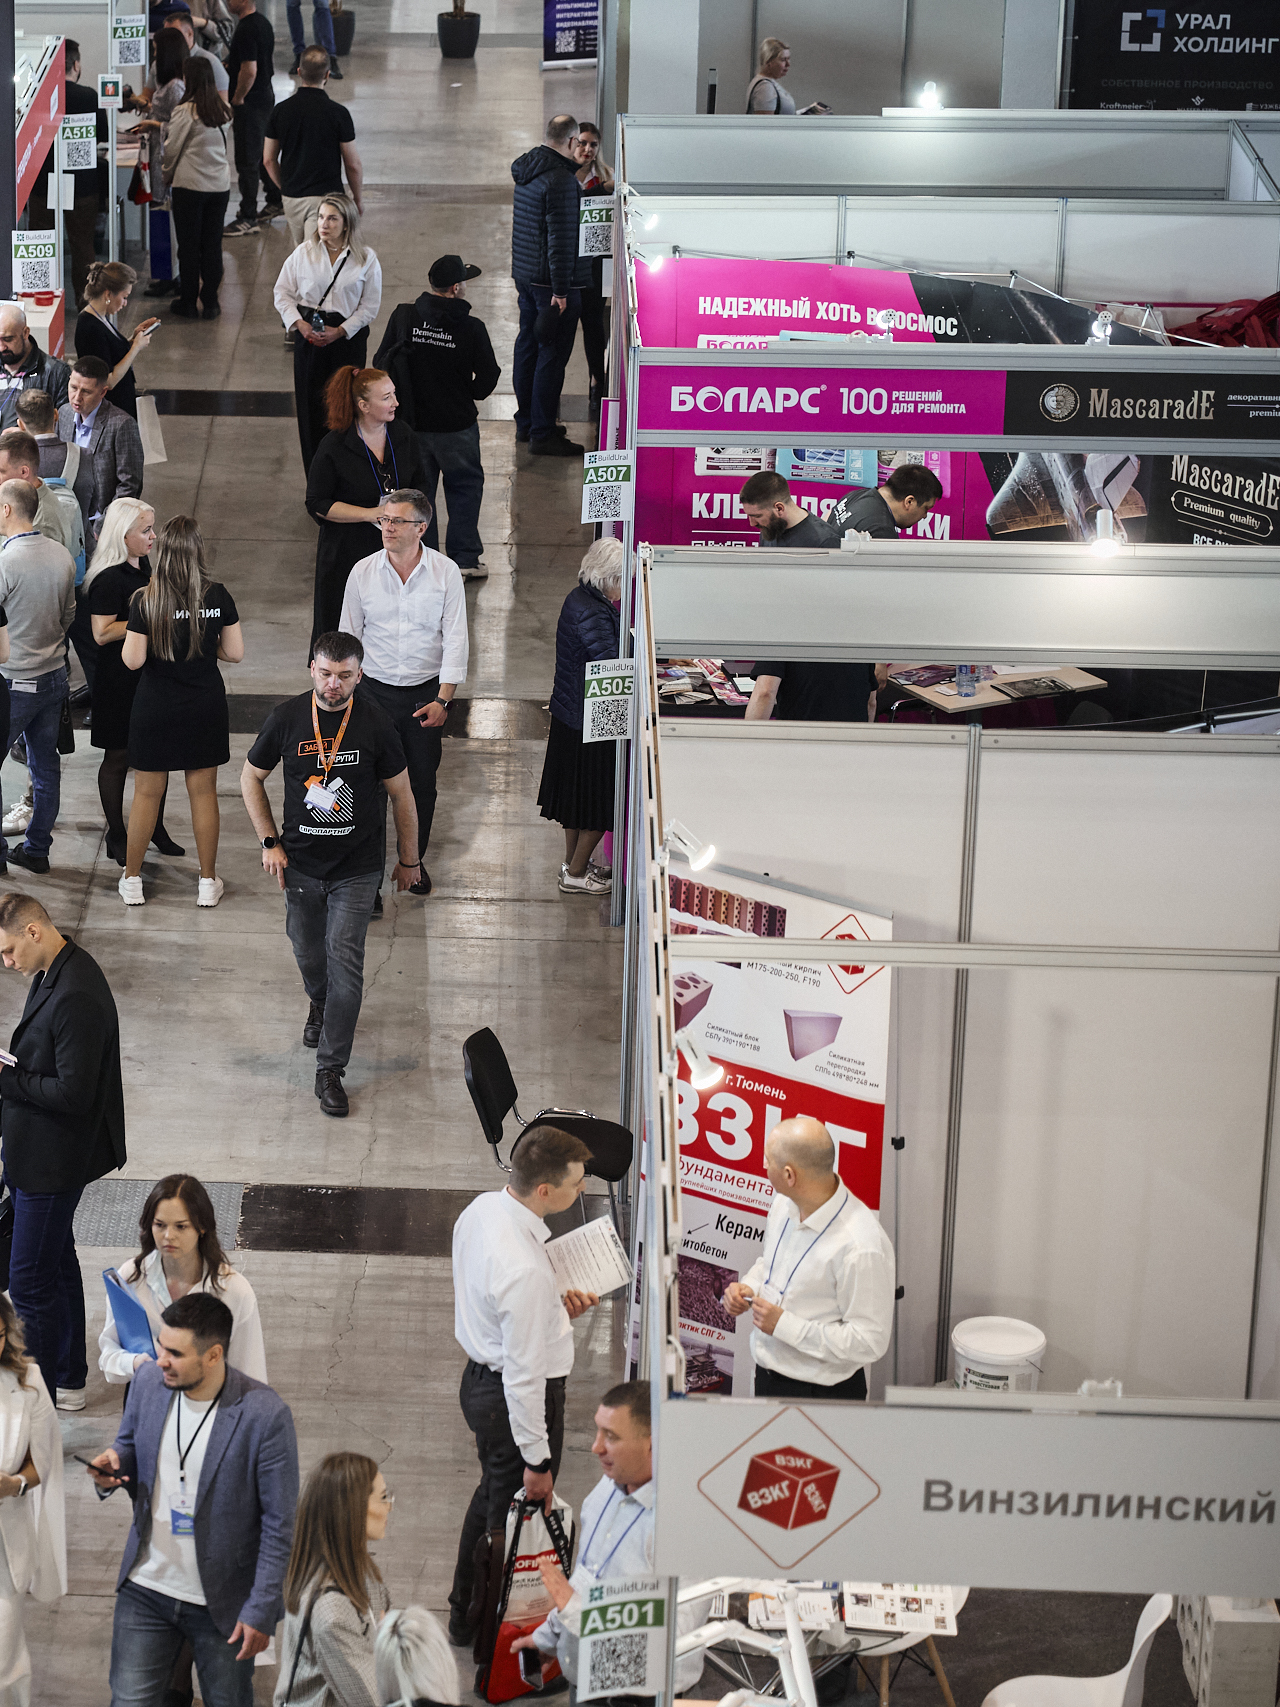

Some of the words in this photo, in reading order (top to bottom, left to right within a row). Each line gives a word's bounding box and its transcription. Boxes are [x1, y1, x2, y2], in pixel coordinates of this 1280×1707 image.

[1175, 13, 1231, 30] УРАЛ
[115, 26, 145, 39] A517
[1173, 36, 1280, 53] ХОЛДИНГ
[62, 126, 95, 139] A513
[581, 209, 614, 223] A511
[25, 233, 52, 241] BuildUral
[16, 244, 54, 258] A509
[698, 296, 810, 318] НАДЕЖНЫЙ
[816, 301, 861, 323] ХОТЬ
[891, 310, 959, 336] ОСМОС
[412, 328, 452, 340] Demenshin
[706, 340, 769, 350] БОЛАР
[670, 386, 820, 414] БОЛАРС
[839, 387, 888, 415] 100
[892, 390, 943, 402] РЕШЕНИЙ
[1088, 388, 1216, 420] MascaradE
[891, 403, 915, 415] ДЛЯ
[917, 403, 966, 414] РЕМОНТА
[1249, 409, 1280, 418] premiu
[597, 453, 629, 462] BuildUral
[585, 466, 628, 484] A507
[692, 493, 748, 519] КЛЕ
[1183, 496, 1225, 518] Premium
[1229, 511, 1261, 530] quality
[601, 663, 634, 672] BuildUra
[586, 678, 633, 697] A505
[304, 741, 328, 752] ЗАБЙ
[802, 975, 821, 988] F190
[706, 1022, 744, 1038] Силикатный
[744, 1032, 760, 1043] блок
[828, 1050, 866, 1067] Силикатная
[826, 1060, 867, 1077] перегородка
[725, 1073, 787, 1101] г.Тюмень
[680, 1178, 717, 1194] рупнейших
[715, 1213, 765, 1243] Керам
[681, 1239, 729, 1261] итобетон
[701, 1328, 716, 1339] СПГ
[775, 1453, 813, 1470] ВЗКГ
[747, 1478, 791, 1510] ВЗКГ
[804, 1482, 827, 1514] ВЗКГ
[923, 1478, 1277, 1525] Винзилинский
[606, 1580, 659, 1595] BuildUral
[583, 1601, 654, 1635] A501
